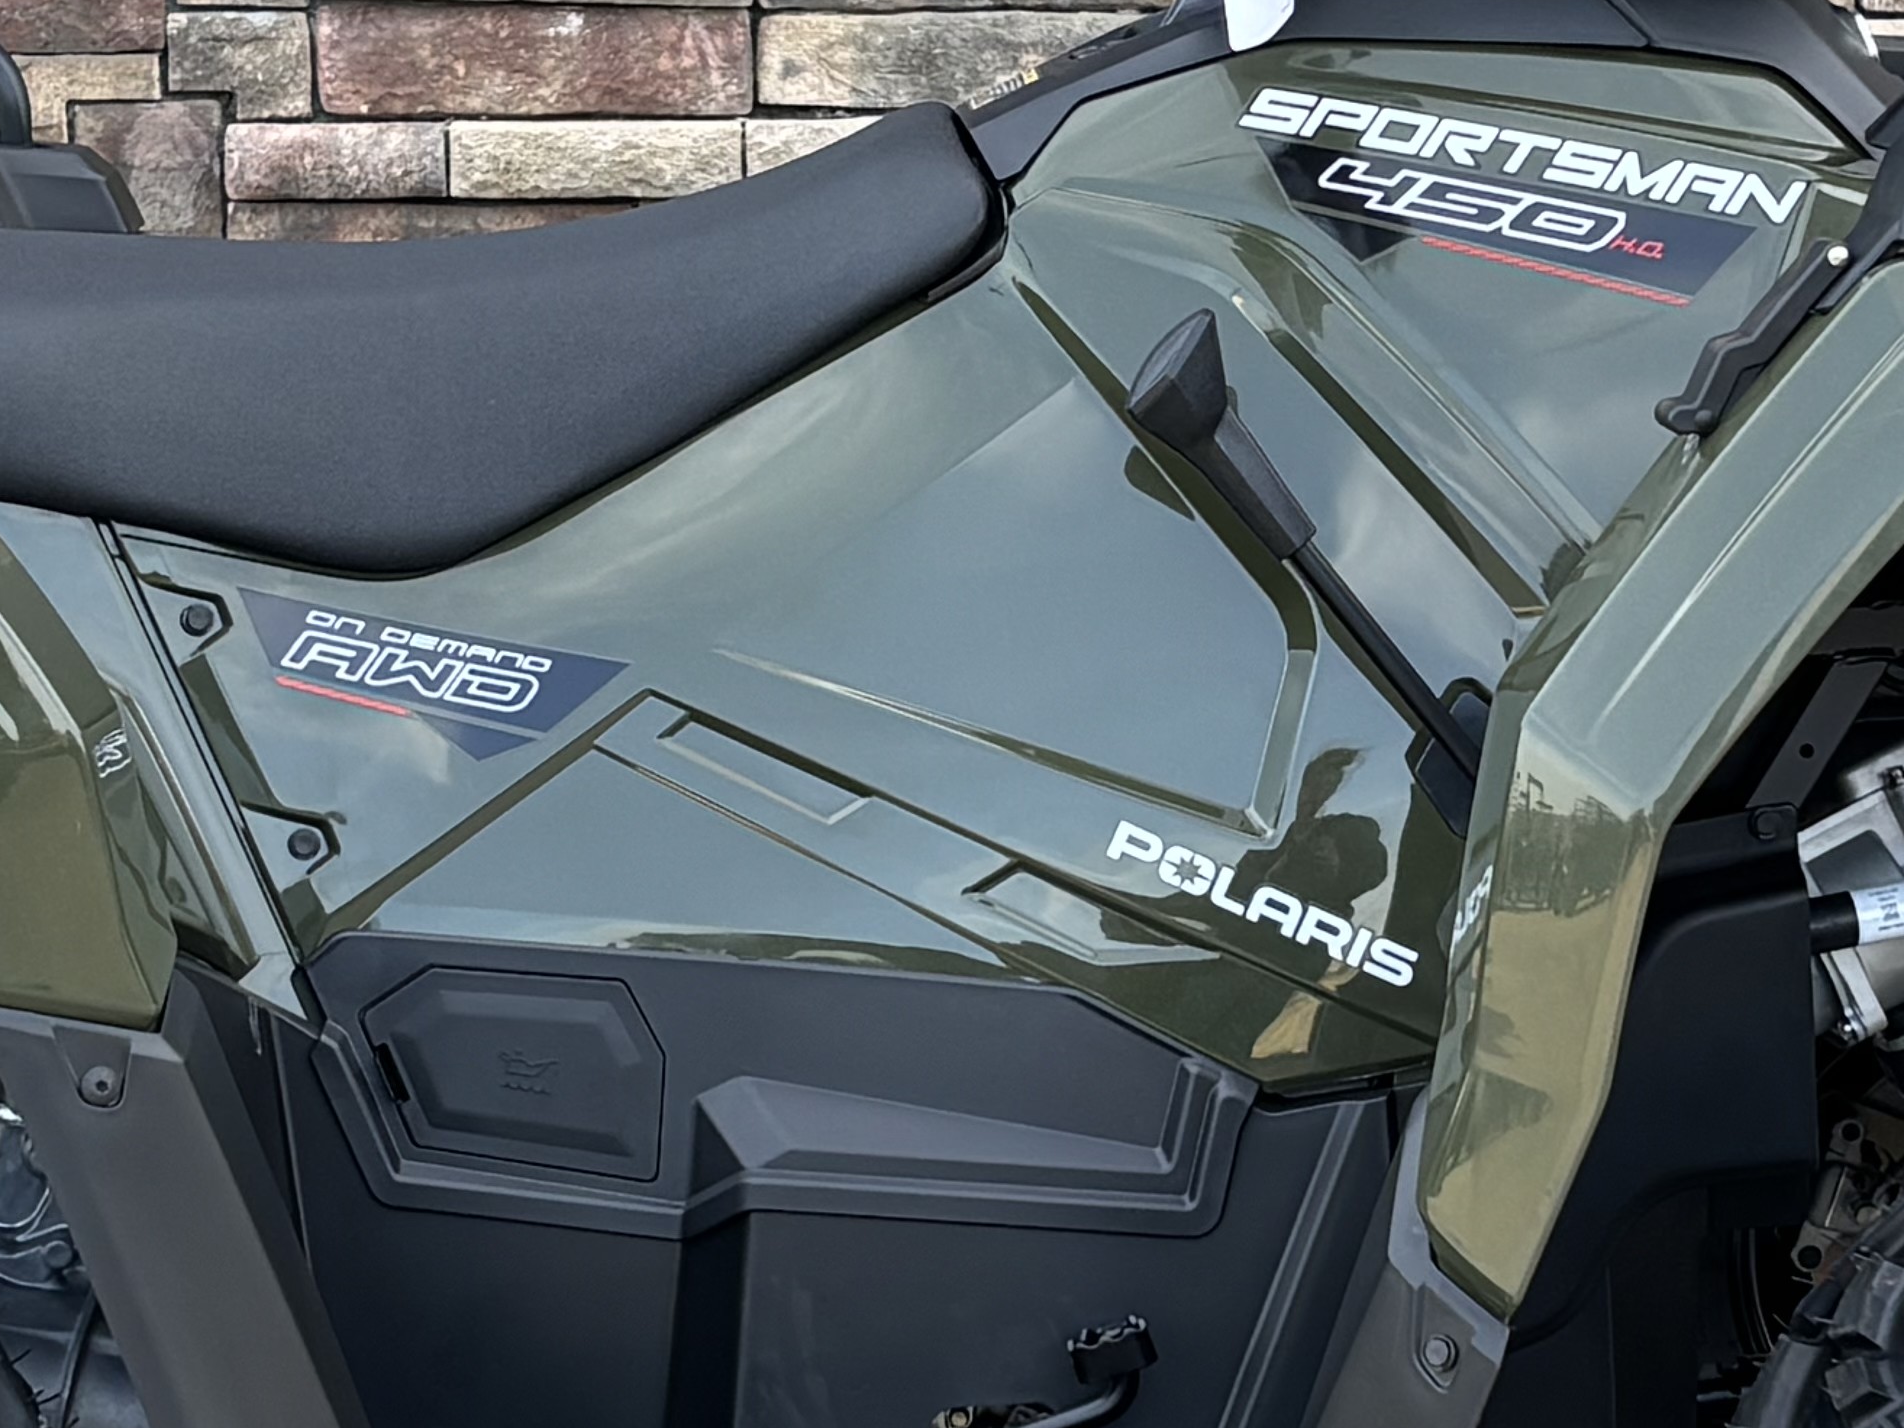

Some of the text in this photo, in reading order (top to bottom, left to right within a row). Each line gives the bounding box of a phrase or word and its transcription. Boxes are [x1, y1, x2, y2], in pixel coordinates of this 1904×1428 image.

[1238, 87, 1808, 224] SPORTSMAN
[1317, 156, 1627, 253] 450
[279, 629, 540, 713] AWD
[380, 626, 553, 673] DEMAND
[1105, 819, 1420, 988] POLARIS
